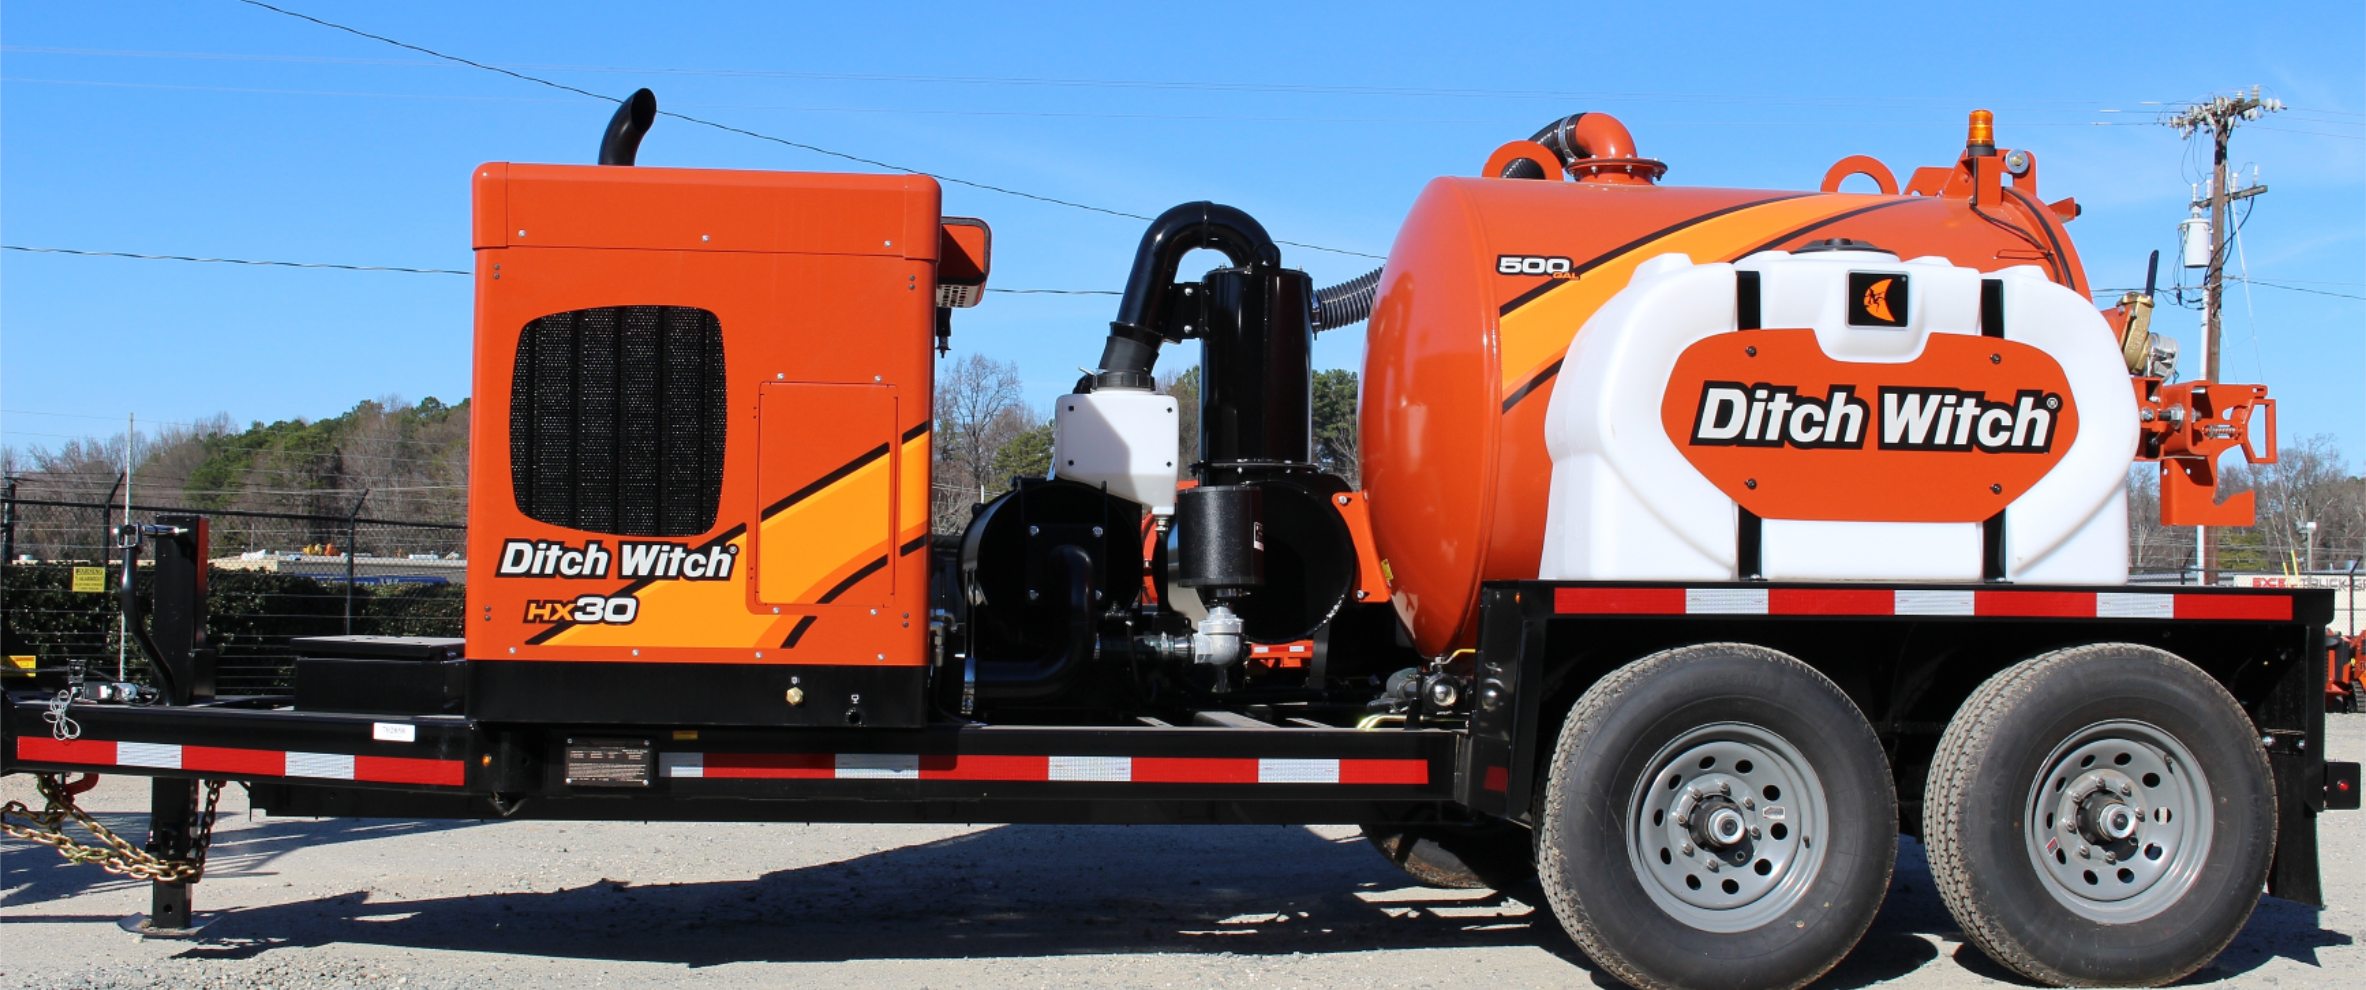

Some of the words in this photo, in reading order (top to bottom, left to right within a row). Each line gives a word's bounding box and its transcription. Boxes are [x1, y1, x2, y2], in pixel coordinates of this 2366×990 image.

[1499, 256, 1570, 275] 500
[1697, 387, 1864, 443] Ditch
[1883, 393, 2052, 447] Witch
[500, 541, 609, 576] Ditch
[621, 543, 733, 578] Witch
[2253, 577, 2295, 589] EXCE
[526, 597, 638, 623] HX30
